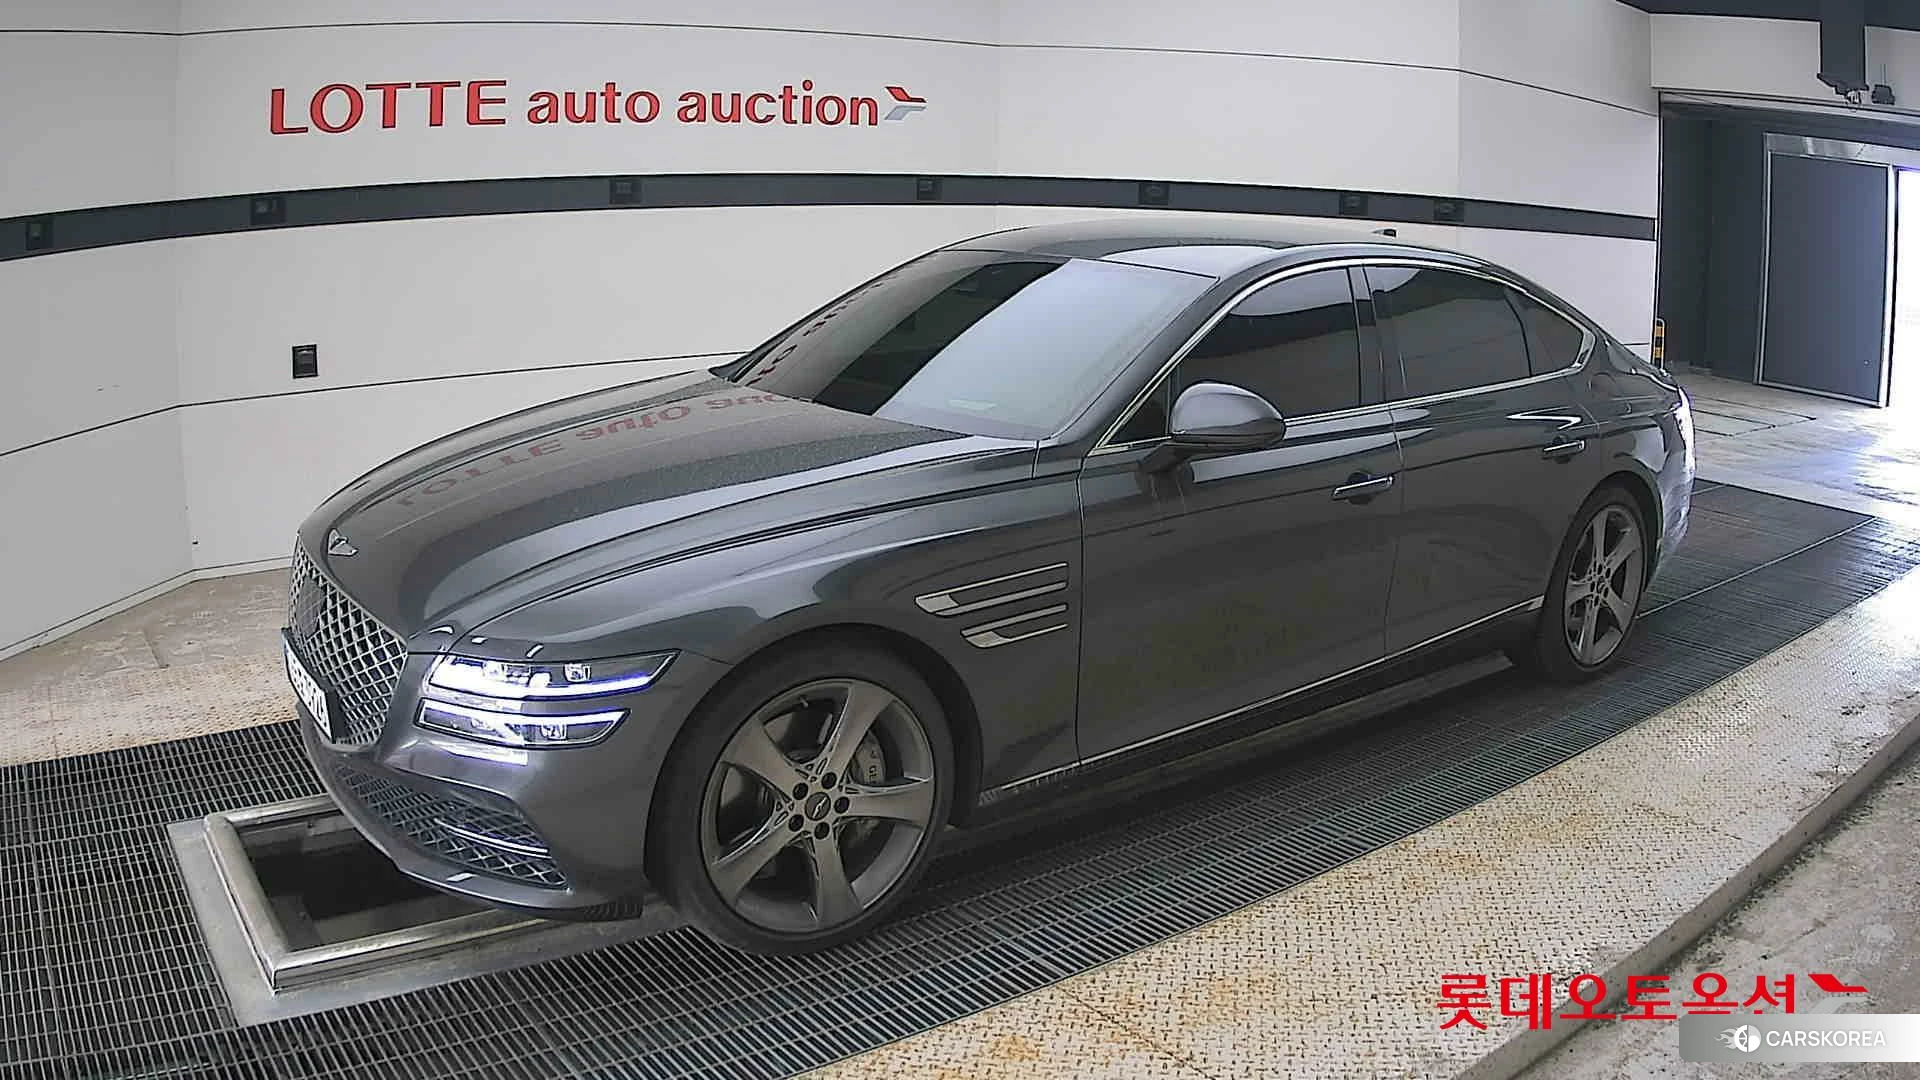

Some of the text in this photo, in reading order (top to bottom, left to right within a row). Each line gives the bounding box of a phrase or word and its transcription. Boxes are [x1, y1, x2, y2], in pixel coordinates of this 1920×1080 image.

[269, 79, 880, 136] LOTTE auto auction
